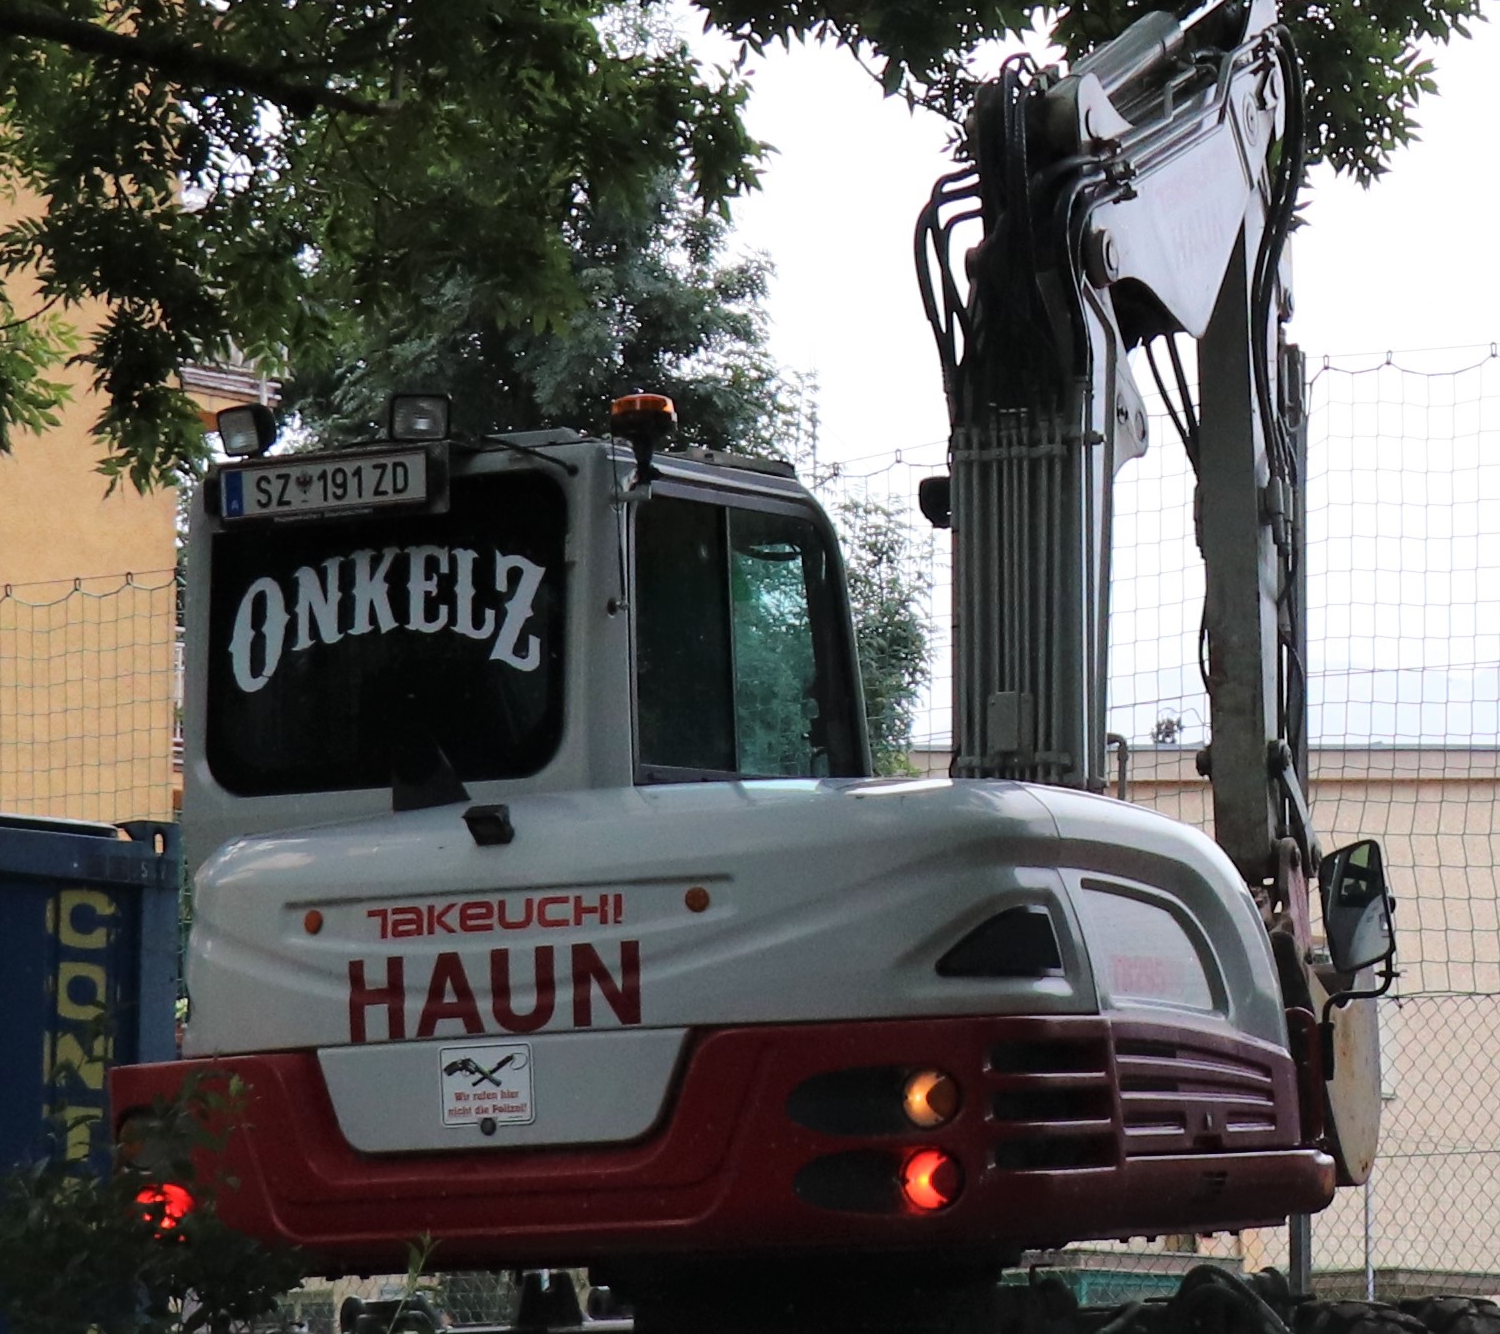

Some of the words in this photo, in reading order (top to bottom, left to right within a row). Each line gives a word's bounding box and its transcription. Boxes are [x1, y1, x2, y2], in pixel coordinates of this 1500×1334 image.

[256, 473, 292, 509] SZ
[228, 545, 546, 693] ONKELZ
[349, 940, 642, 1043] HAUN
[448, 1106, 472, 1117] nicht
[475, 1105, 490, 1115] die
[501, 1089, 519, 1100] hier
